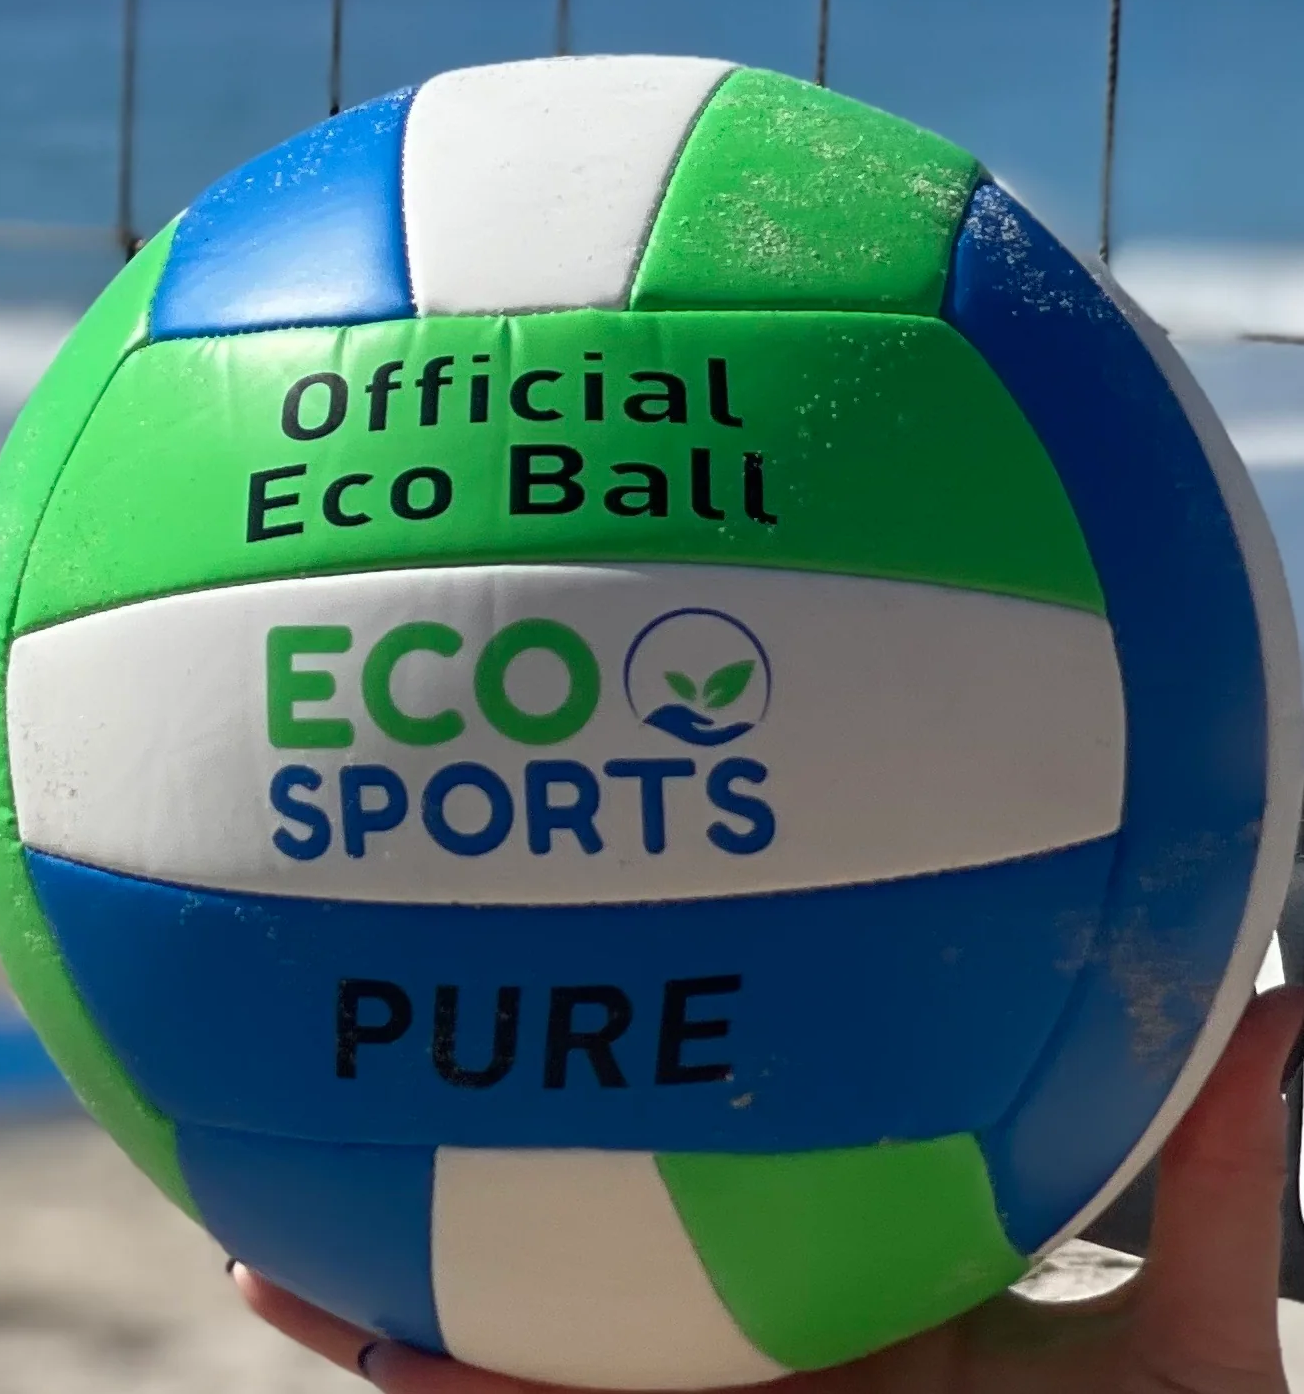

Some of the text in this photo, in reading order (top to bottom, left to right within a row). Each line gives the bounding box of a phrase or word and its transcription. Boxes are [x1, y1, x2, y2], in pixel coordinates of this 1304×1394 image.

[280, 351, 744, 441] Official
[245, 443, 779, 544] Eco Ball
[266, 616, 602, 749] ECO
[268, 756, 777, 861] SPORTS
[335, 973, 742, 1090] PURE
